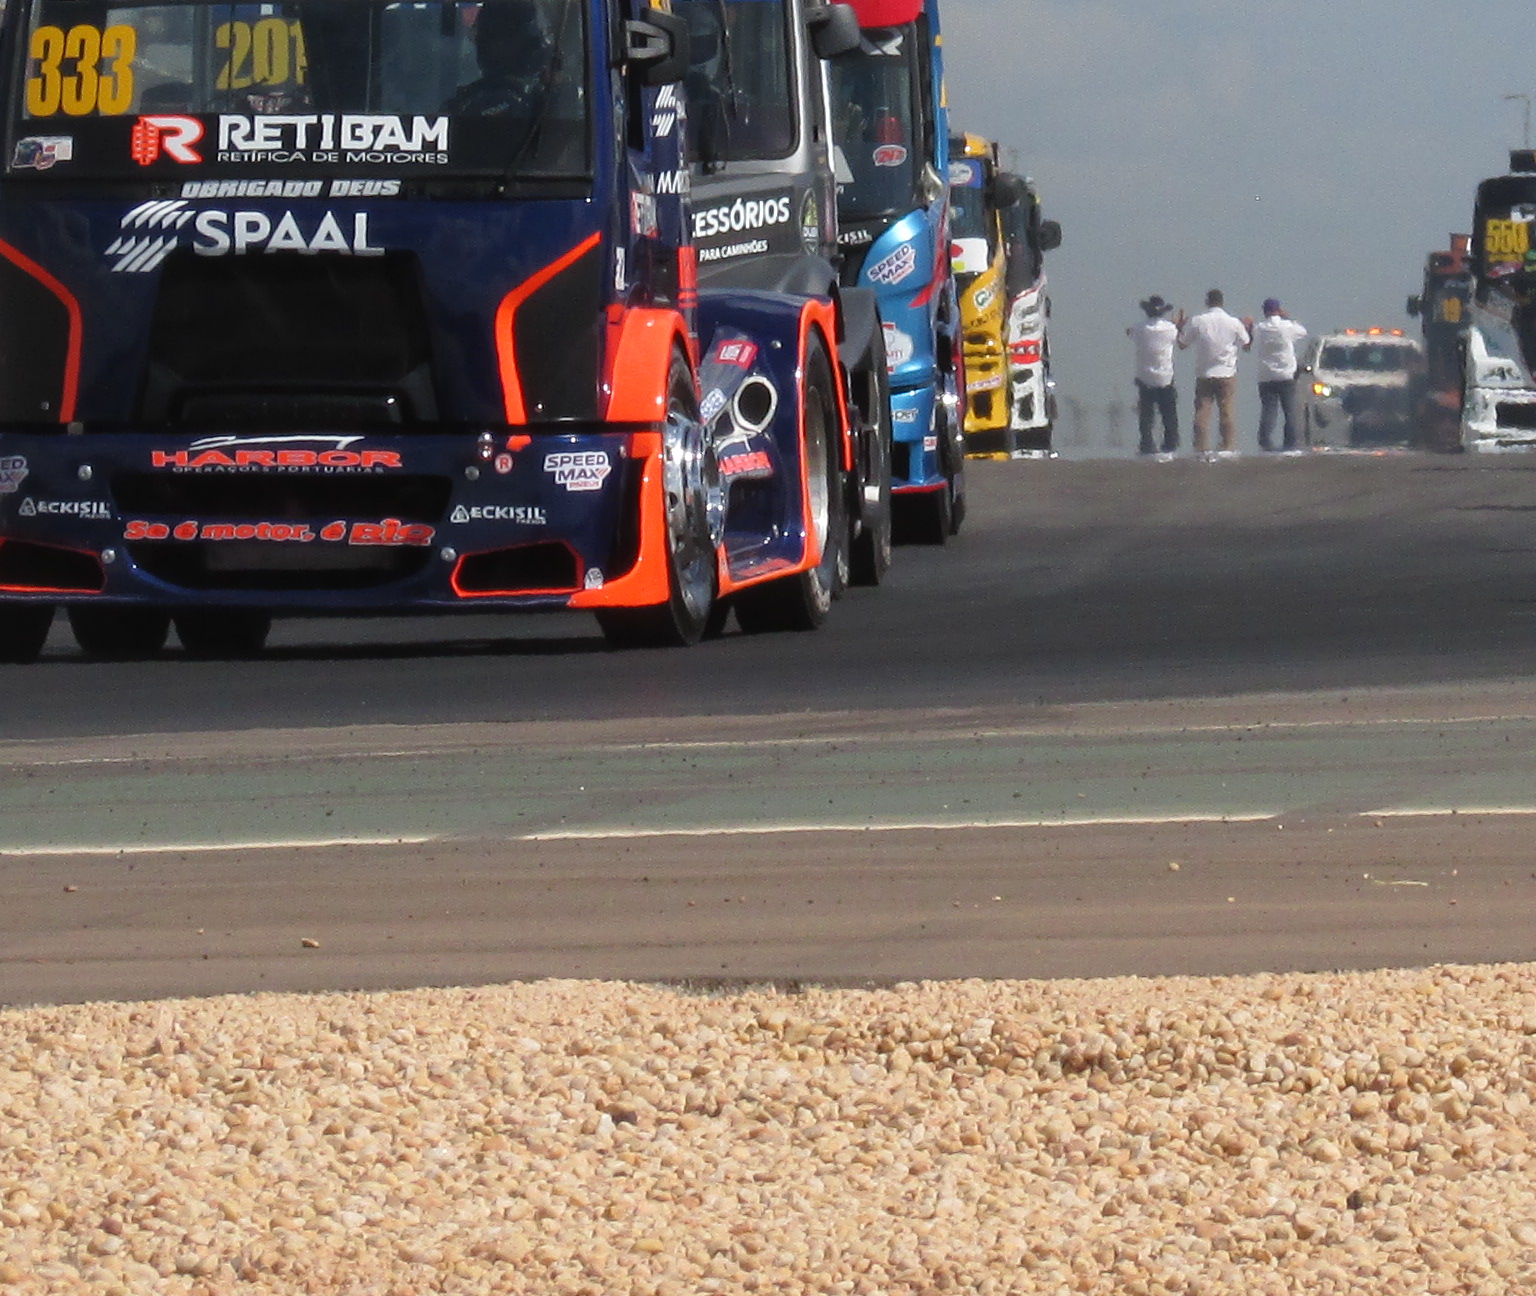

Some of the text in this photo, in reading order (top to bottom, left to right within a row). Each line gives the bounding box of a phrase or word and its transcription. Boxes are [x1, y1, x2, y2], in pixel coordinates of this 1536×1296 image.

[26, 24, 138, 116] 333
[218, 113, 450, 151] RETIBAM
[217, 150, 449, 164] RETÍFICA DE MOTORES
[181, 179, 402, 199] OBRIGADO DEUS
[691, 197, 791, 239] ESSÓRIOS
[192, 210, 386, 256] SPAAL
[698, 239, 769, 263] PARA CAMINHÕES
[869, 244, 911, 278] SPEED
[151, 449, 404, 468] HARBOR
[546, 453, 607, 469] SPEED
[557, 467, 600, 483] MAX
[37, 500, 111, 515] ECKISIL
[470, 505, 545, 520] ECKISIL
